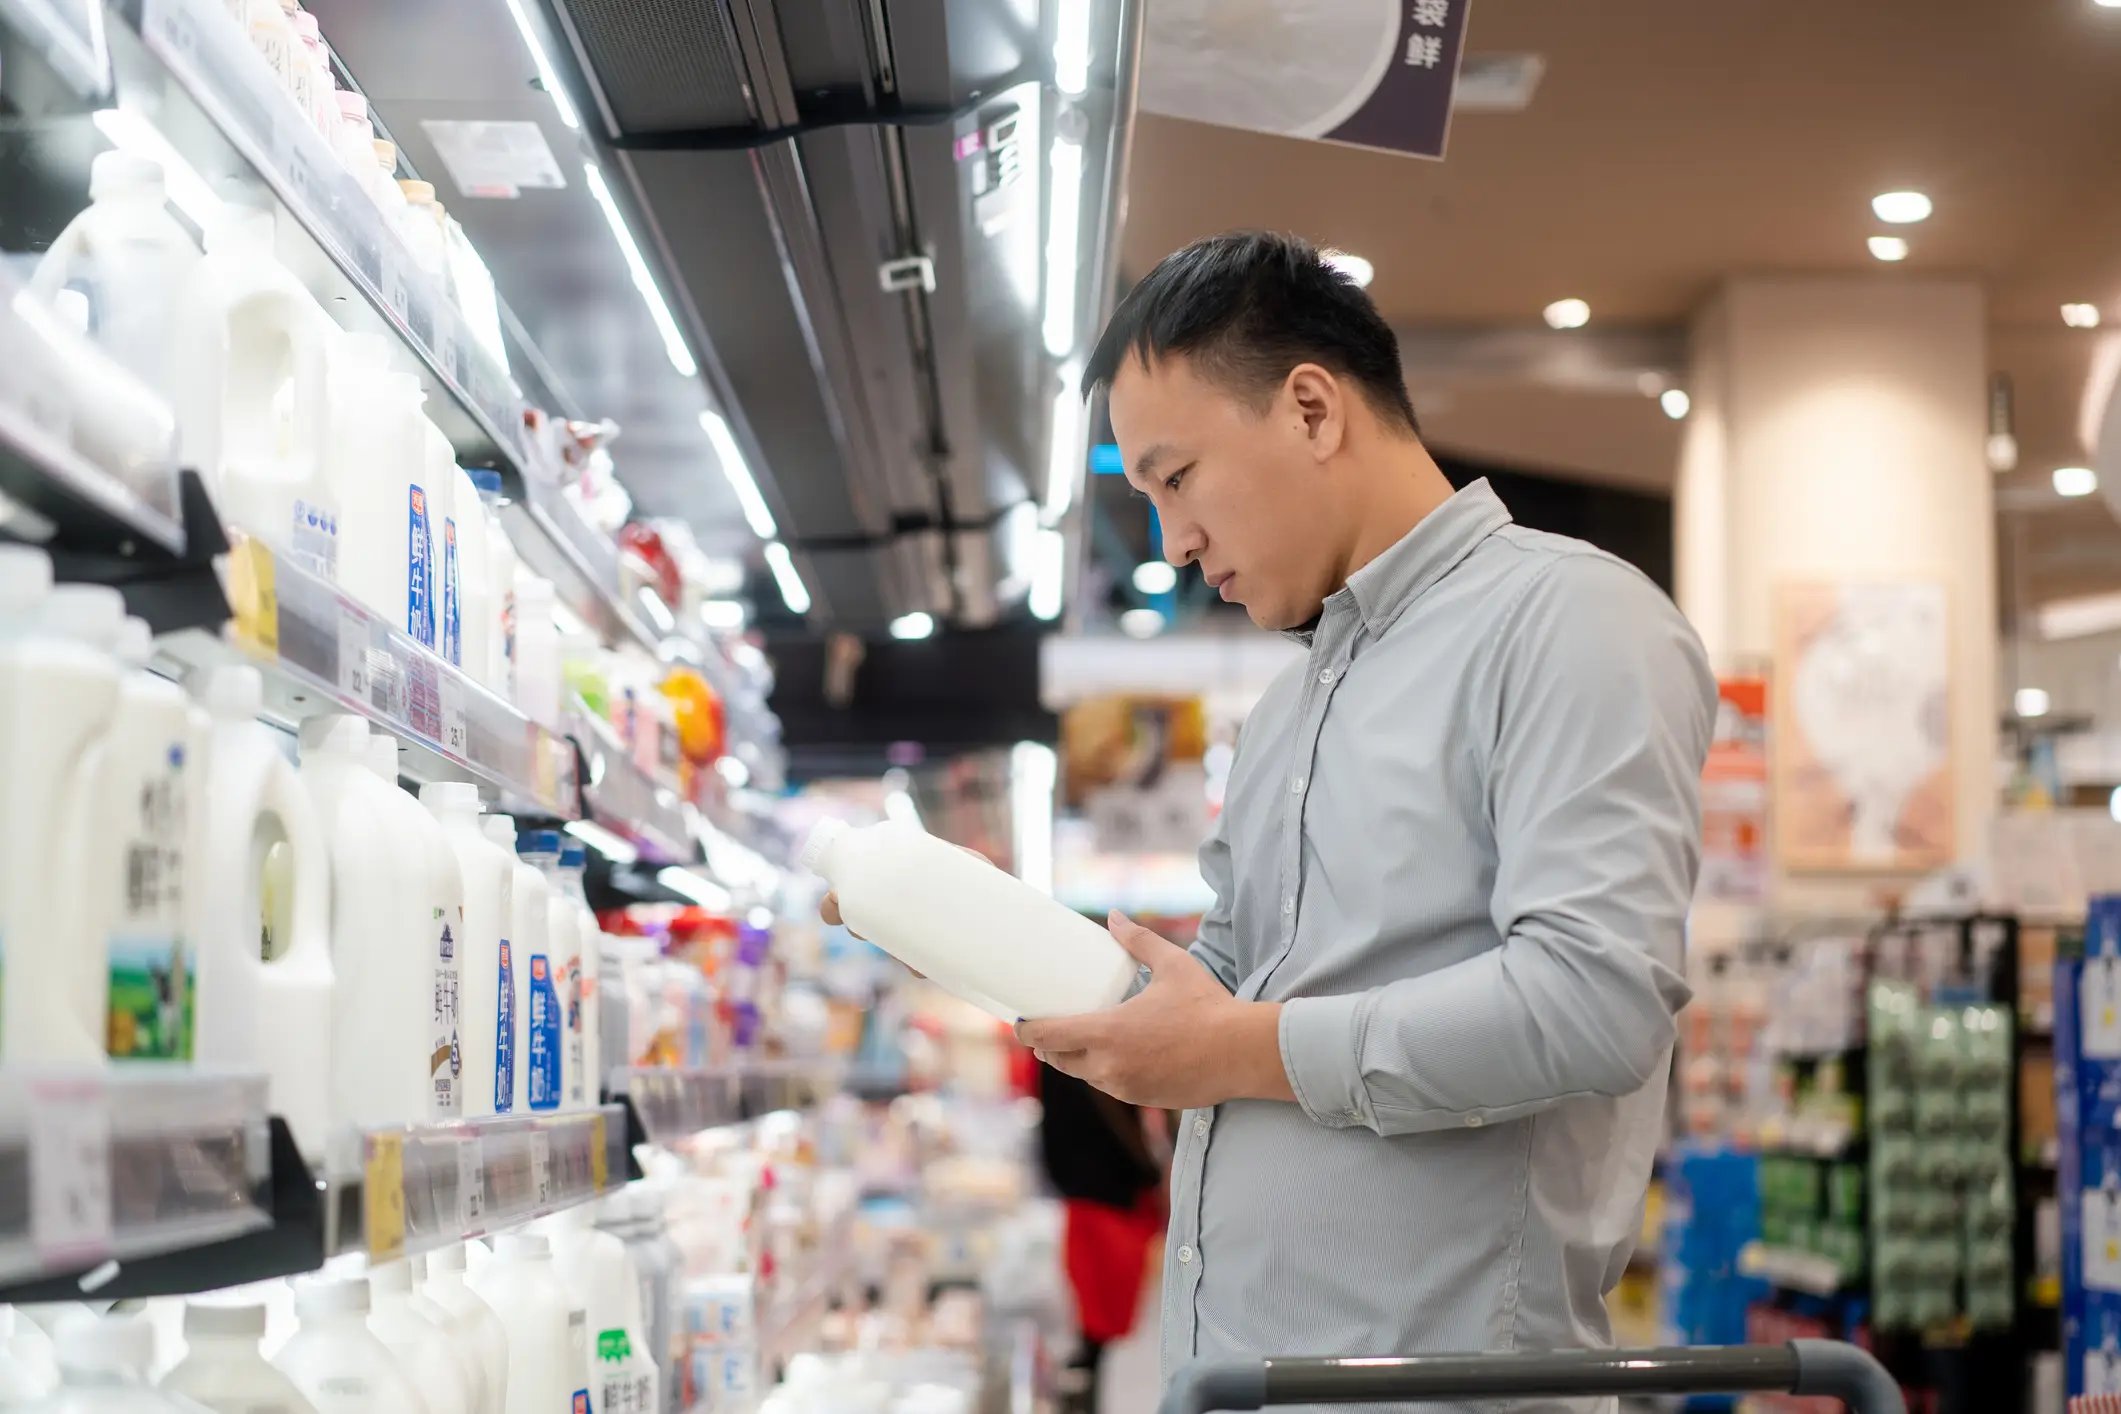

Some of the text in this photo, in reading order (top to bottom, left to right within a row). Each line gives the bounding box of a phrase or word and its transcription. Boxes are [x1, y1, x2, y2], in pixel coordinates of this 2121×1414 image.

[411, 524, 424, 641] 鲜牛奶
[435, 980, 459, 1024] 鲜牛奶
[497, 980, 509, 1105] 鲜牛奶
[532, 990, 546, 1103] 鲜牛奶
